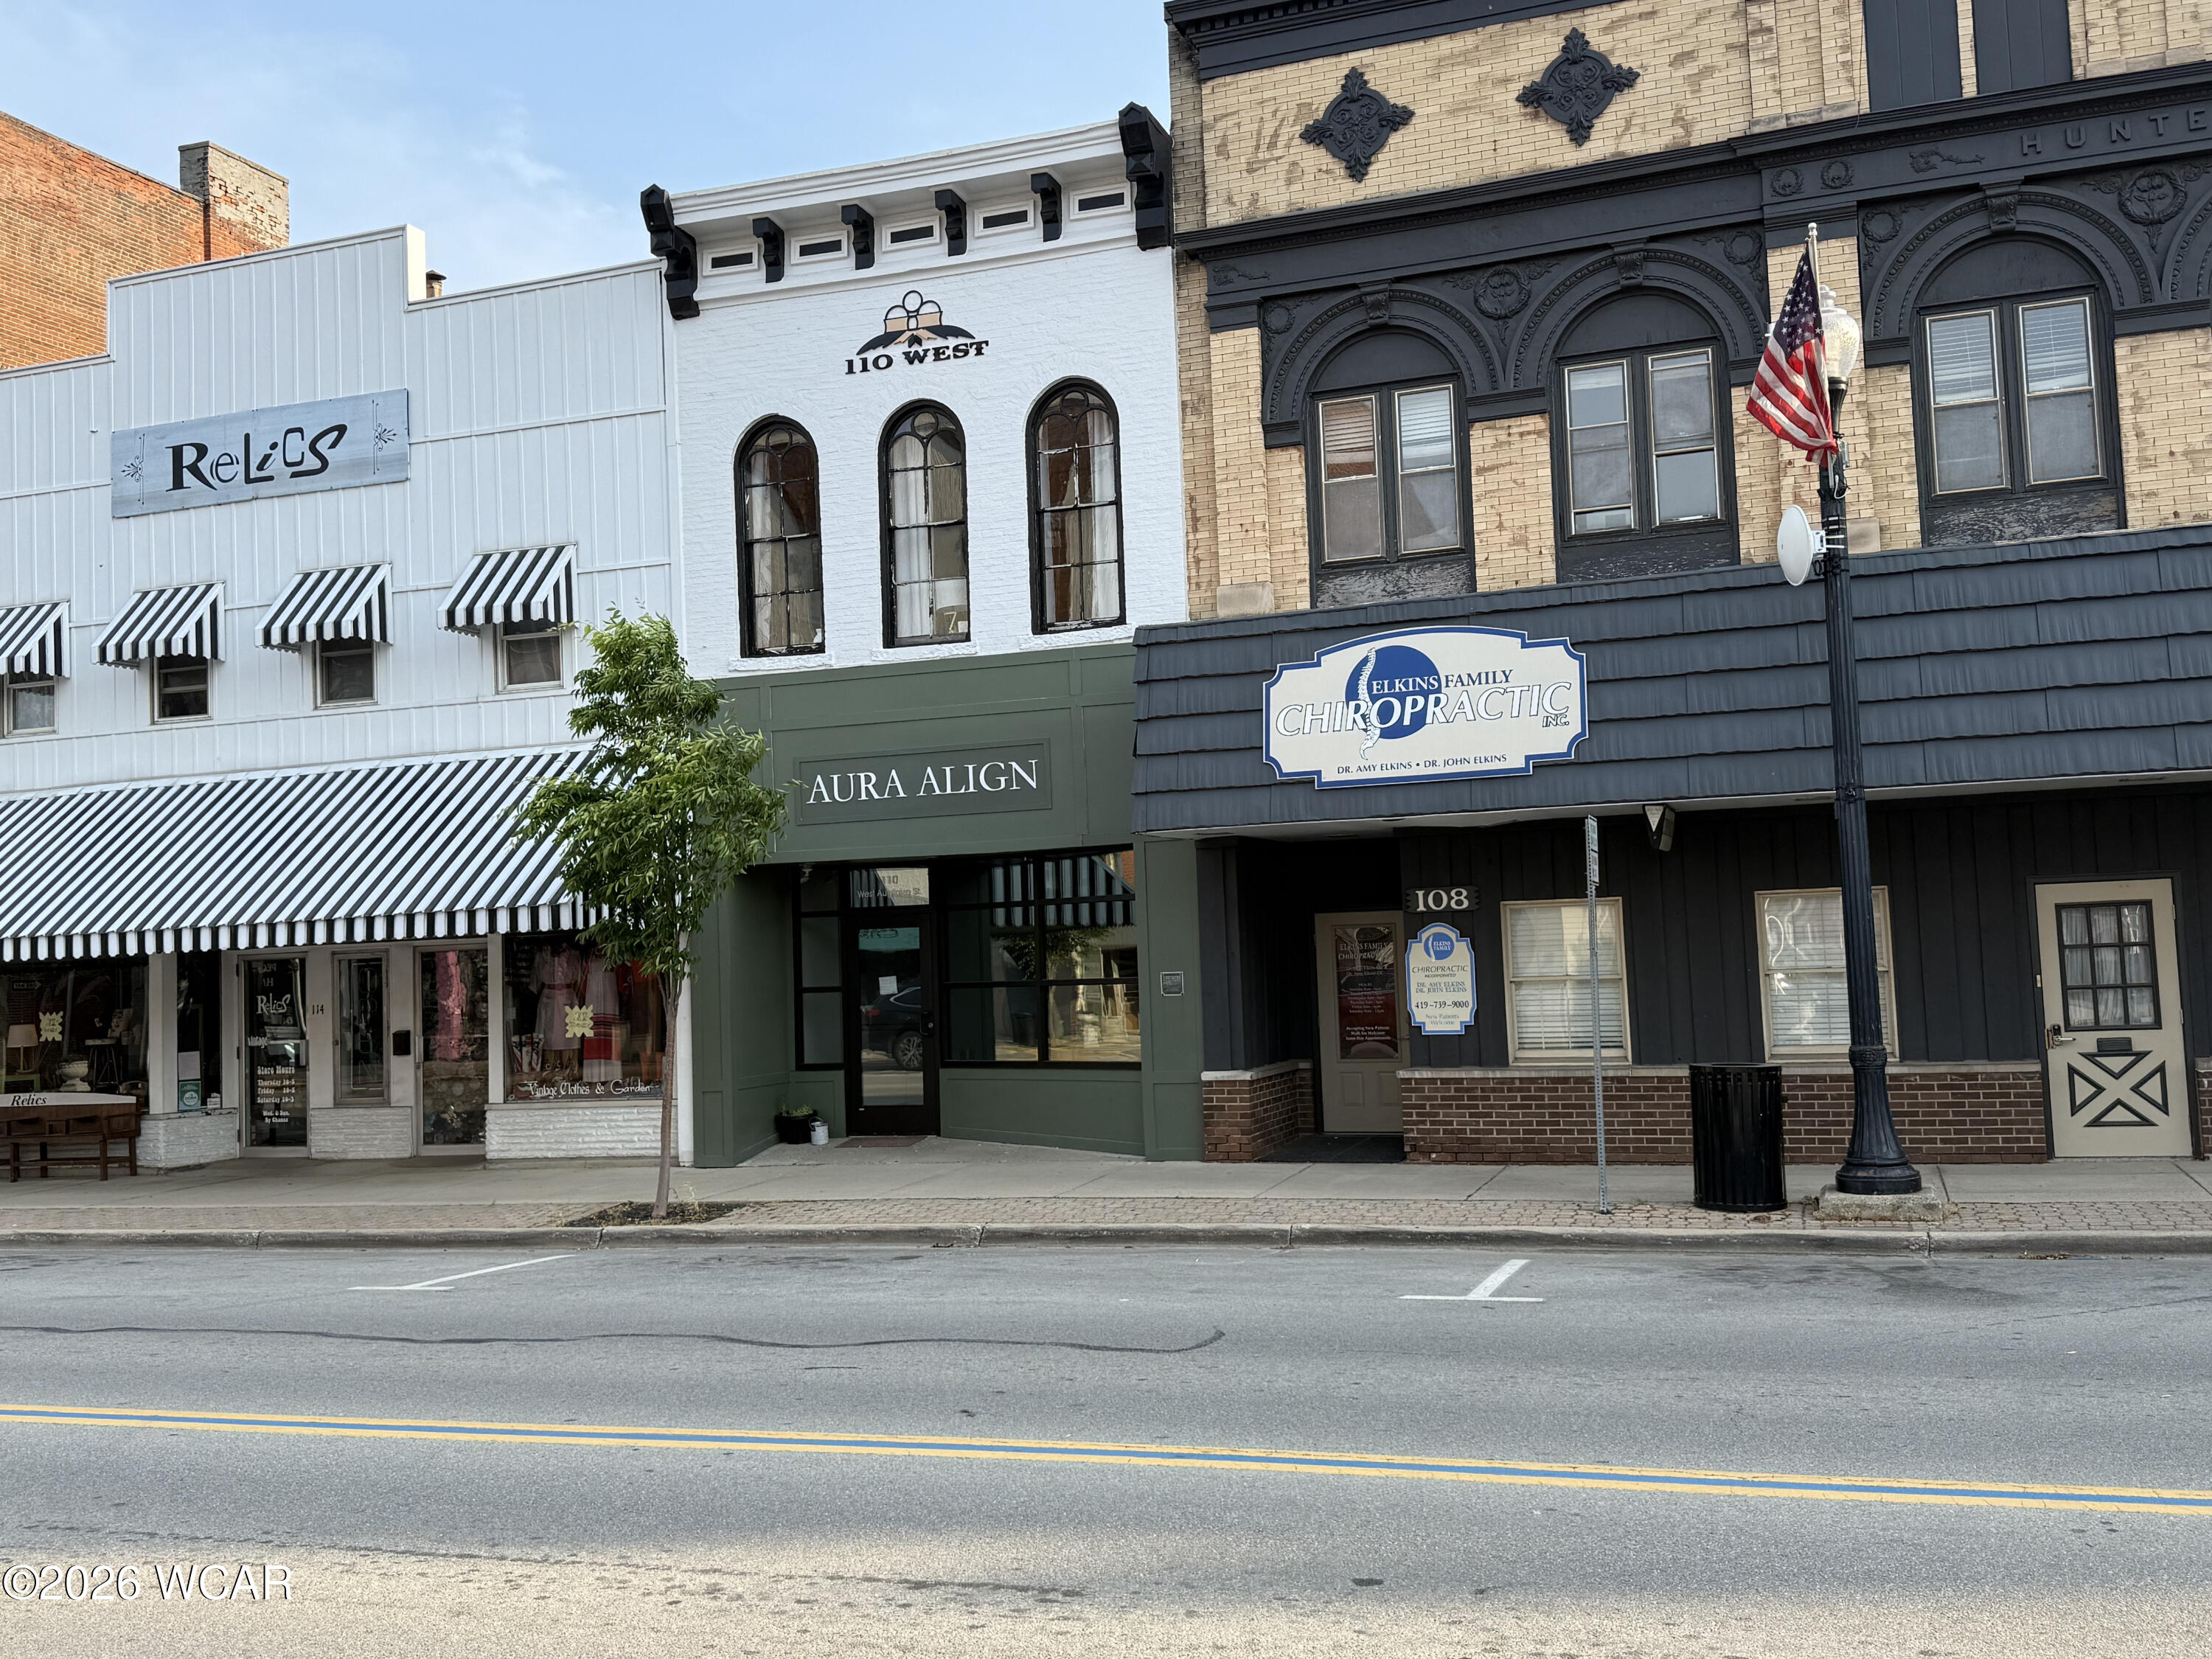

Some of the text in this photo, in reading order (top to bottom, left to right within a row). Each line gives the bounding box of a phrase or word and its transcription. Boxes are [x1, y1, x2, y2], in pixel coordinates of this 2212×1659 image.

[2021, 108, 2207, 156] HUNTE
[845, 340, 990, 375] 110 WEST
[1371, 669, 1514, 695] ELKINS FAMILY
[1276, 681, 1571, 737] CHIROPRACTIC
[1543, 714, 1570, 728] INC.
[1338, 754, 1507, 774] DR. AMY ELKINS DR. JOHN ELKINS
[807, 759, 1039, 804] AURA ALIGN
[858, 890, 875, 898] West
[1416, 888, 1469, 911] 108
[1412, 965, 1468, 973] CHIROPRACTIC
[313, 1004, 324, 1015] 114
[1415, 1001, 1470, 1009] 419-739-9000
[527, 1082, 557, 1098] Vintage
[595, 1082, 605, 1094] &
[611, 1079, 650, 1094] Garden
[11, 1093, 47, 1106] Relics
